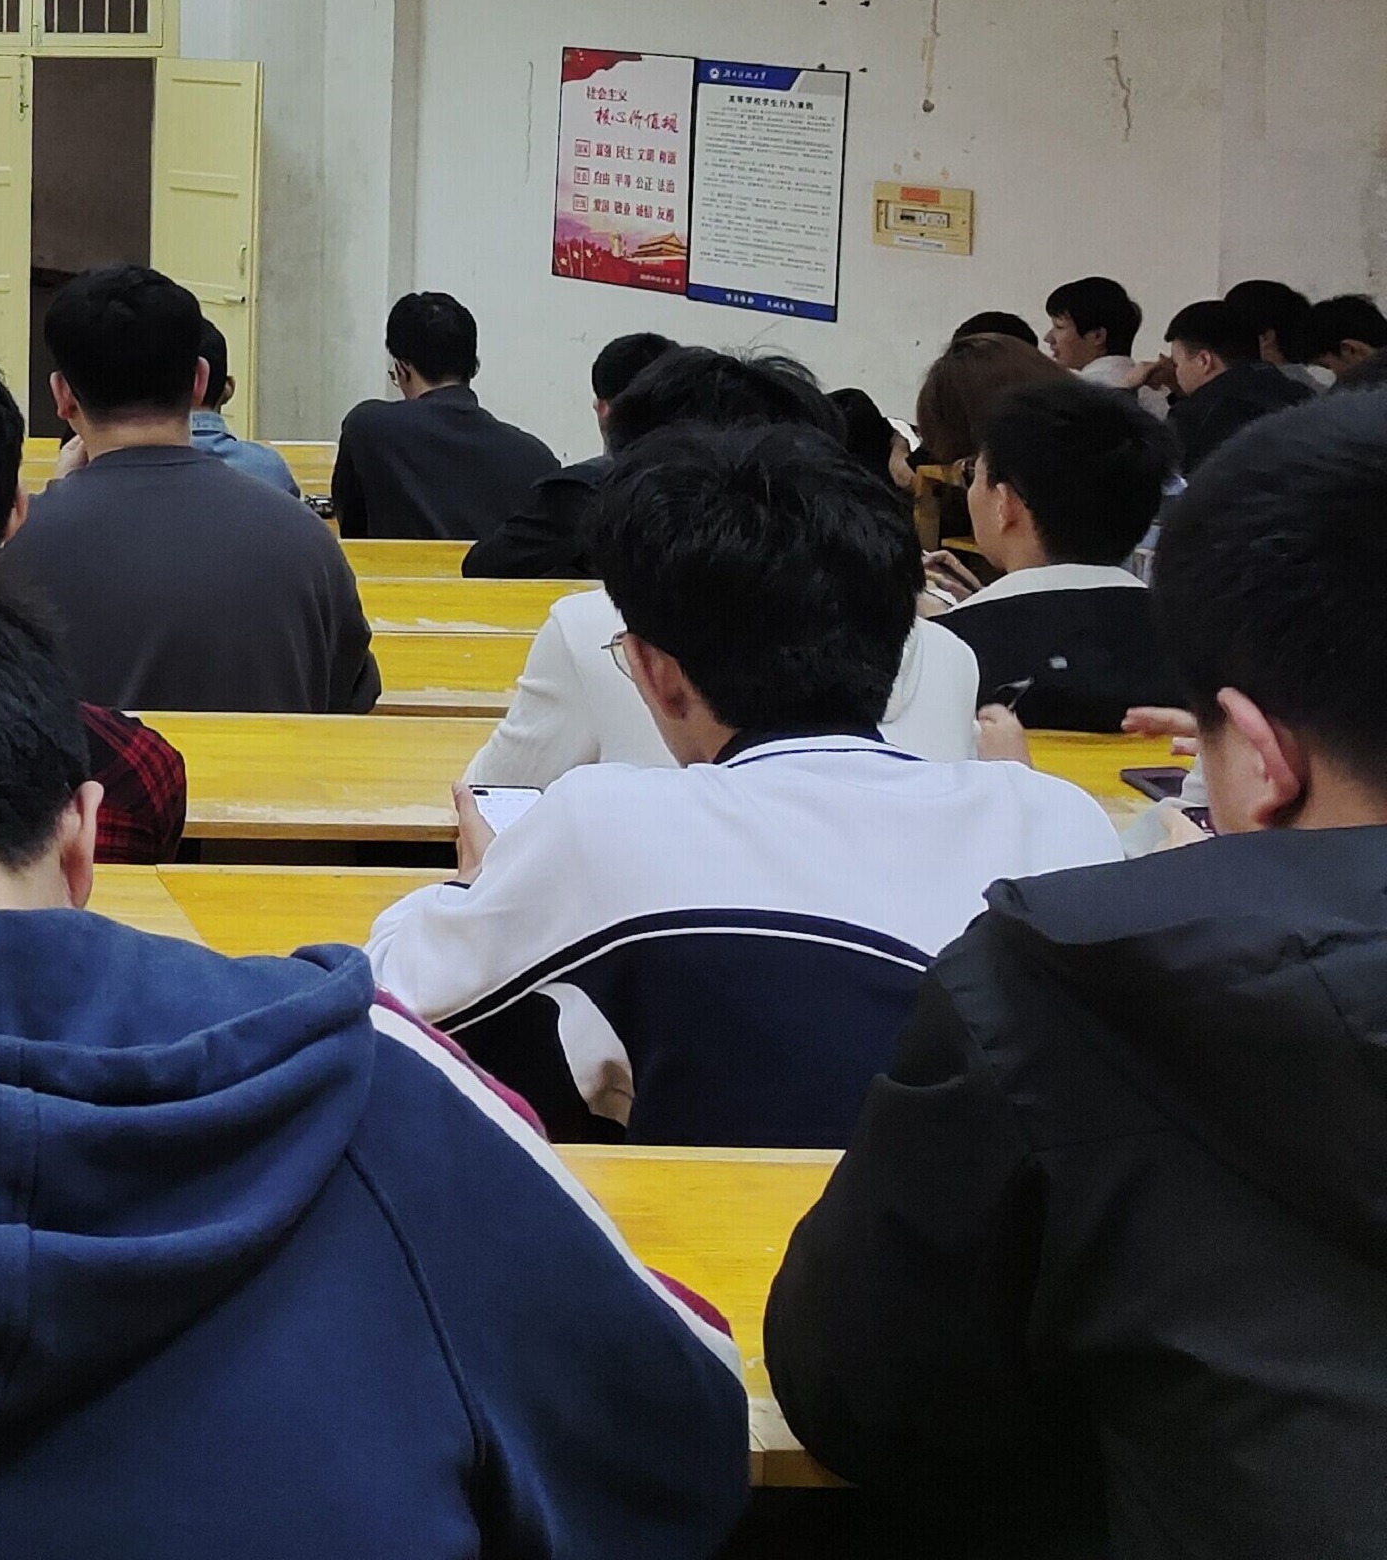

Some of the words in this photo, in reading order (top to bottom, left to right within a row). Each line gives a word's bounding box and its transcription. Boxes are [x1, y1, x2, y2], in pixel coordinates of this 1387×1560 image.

[586, 85, 628, 102] 社会主义
[594, 106, 679, 134] 核心价值观
[595, 143, 612, 159] 富强
[616, 145, 634, 160] 民主
[637, 148, 655, 163] 文明
[593, 170, 610, 185] 自由
[614, 173, 632, 188] 平等
[635, 176, 654, 192] 公正
[657, 178, 675, 194] 法治
